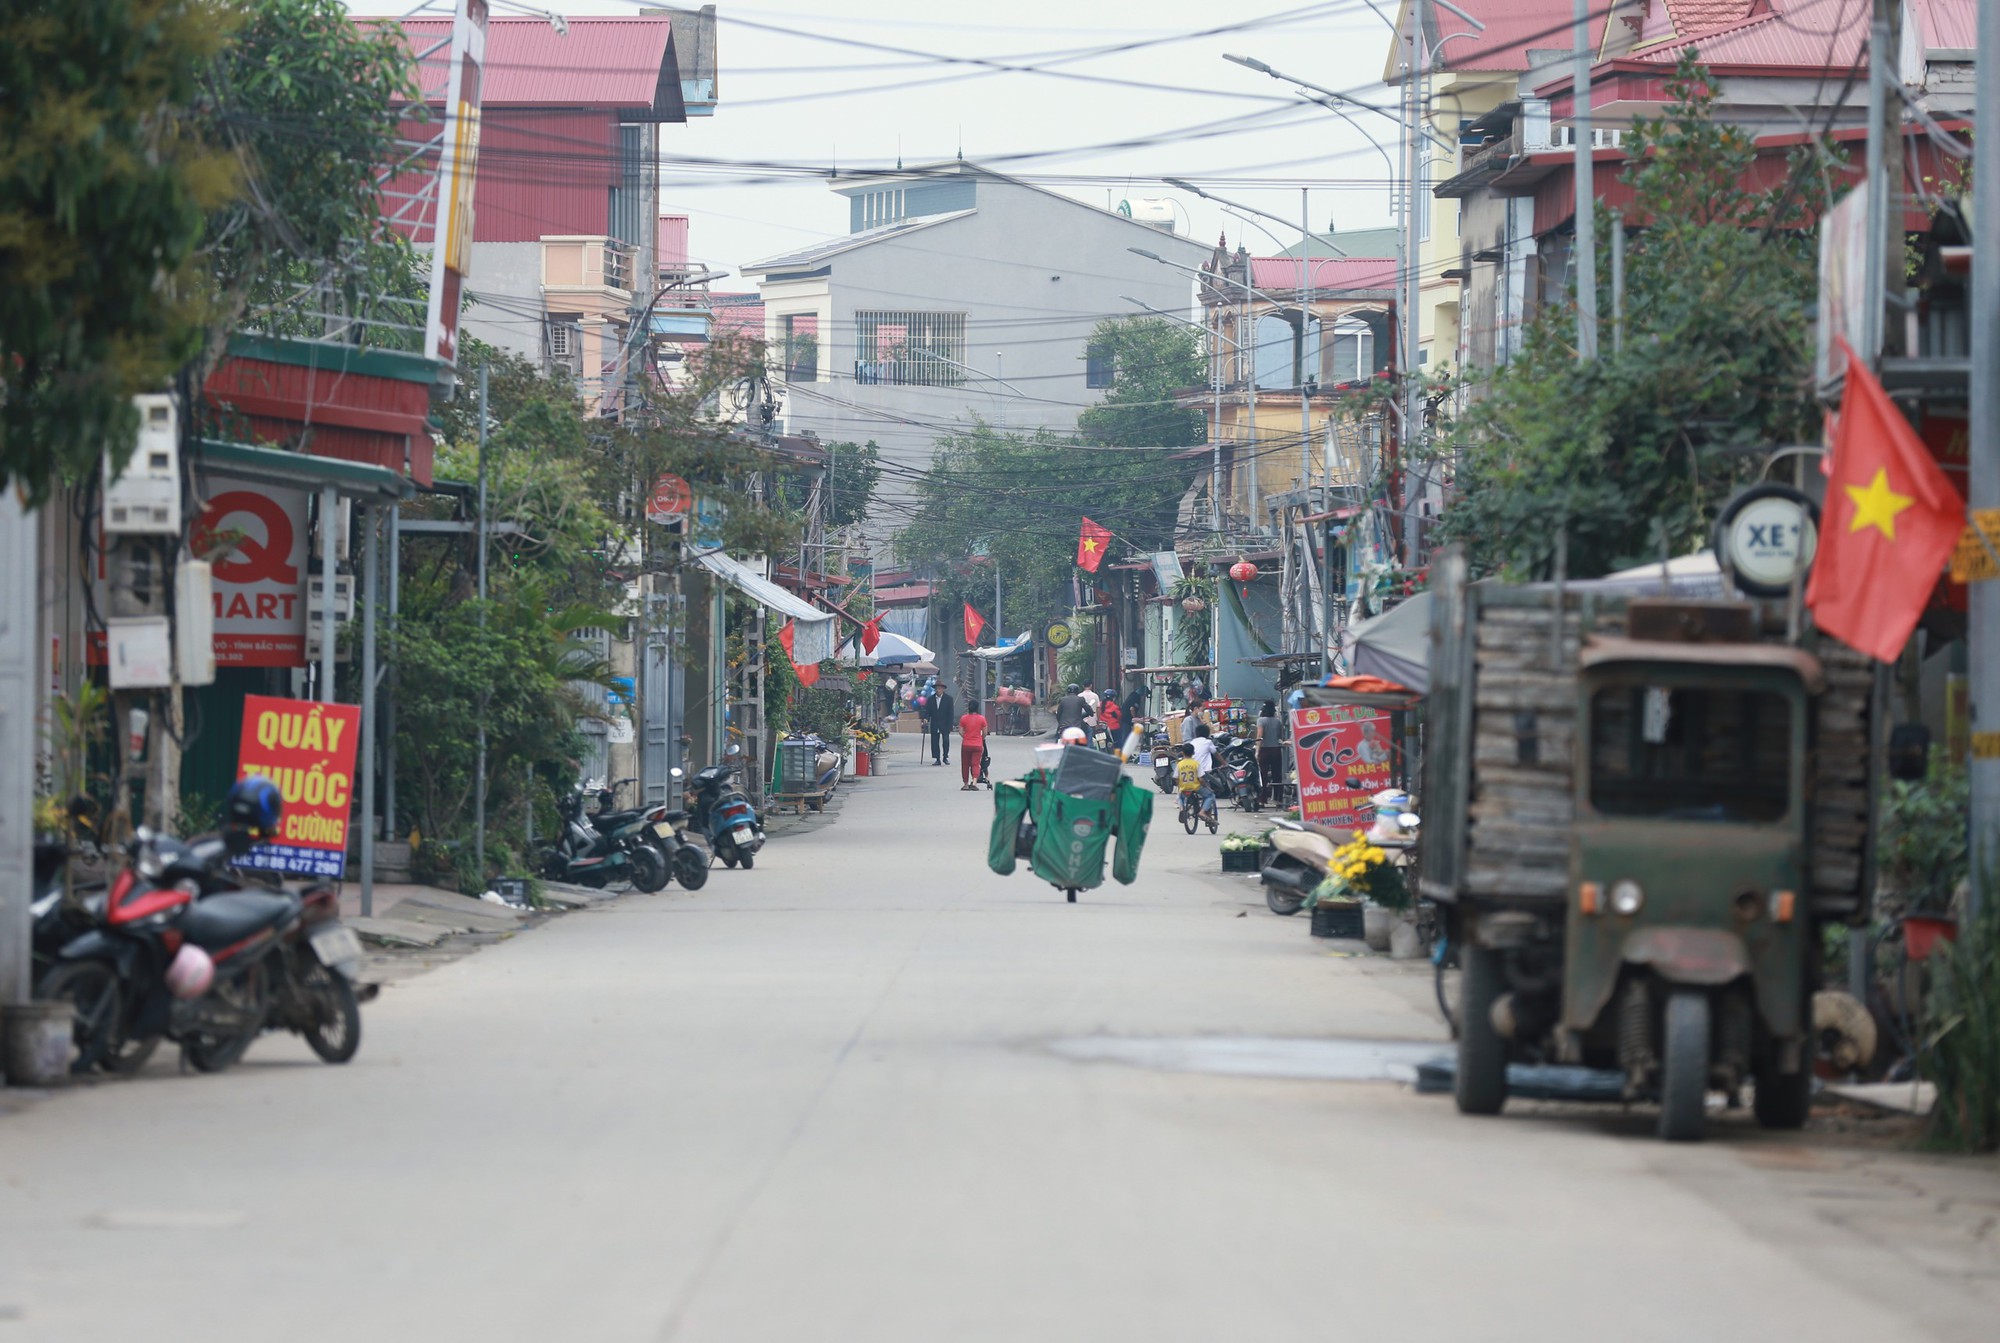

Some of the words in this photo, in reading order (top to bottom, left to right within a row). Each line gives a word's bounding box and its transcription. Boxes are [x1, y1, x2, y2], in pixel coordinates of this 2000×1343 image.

[189, 490, 298, 585] Q
[1748, 525, 1784, 547] XE
[1299, 727, 1362, 780] Tóc
[1181, 771, 1195, 783] 23
[1302, 782, 1323, 796] UỐN
[1328, 782, 1340, 794] ÉP
